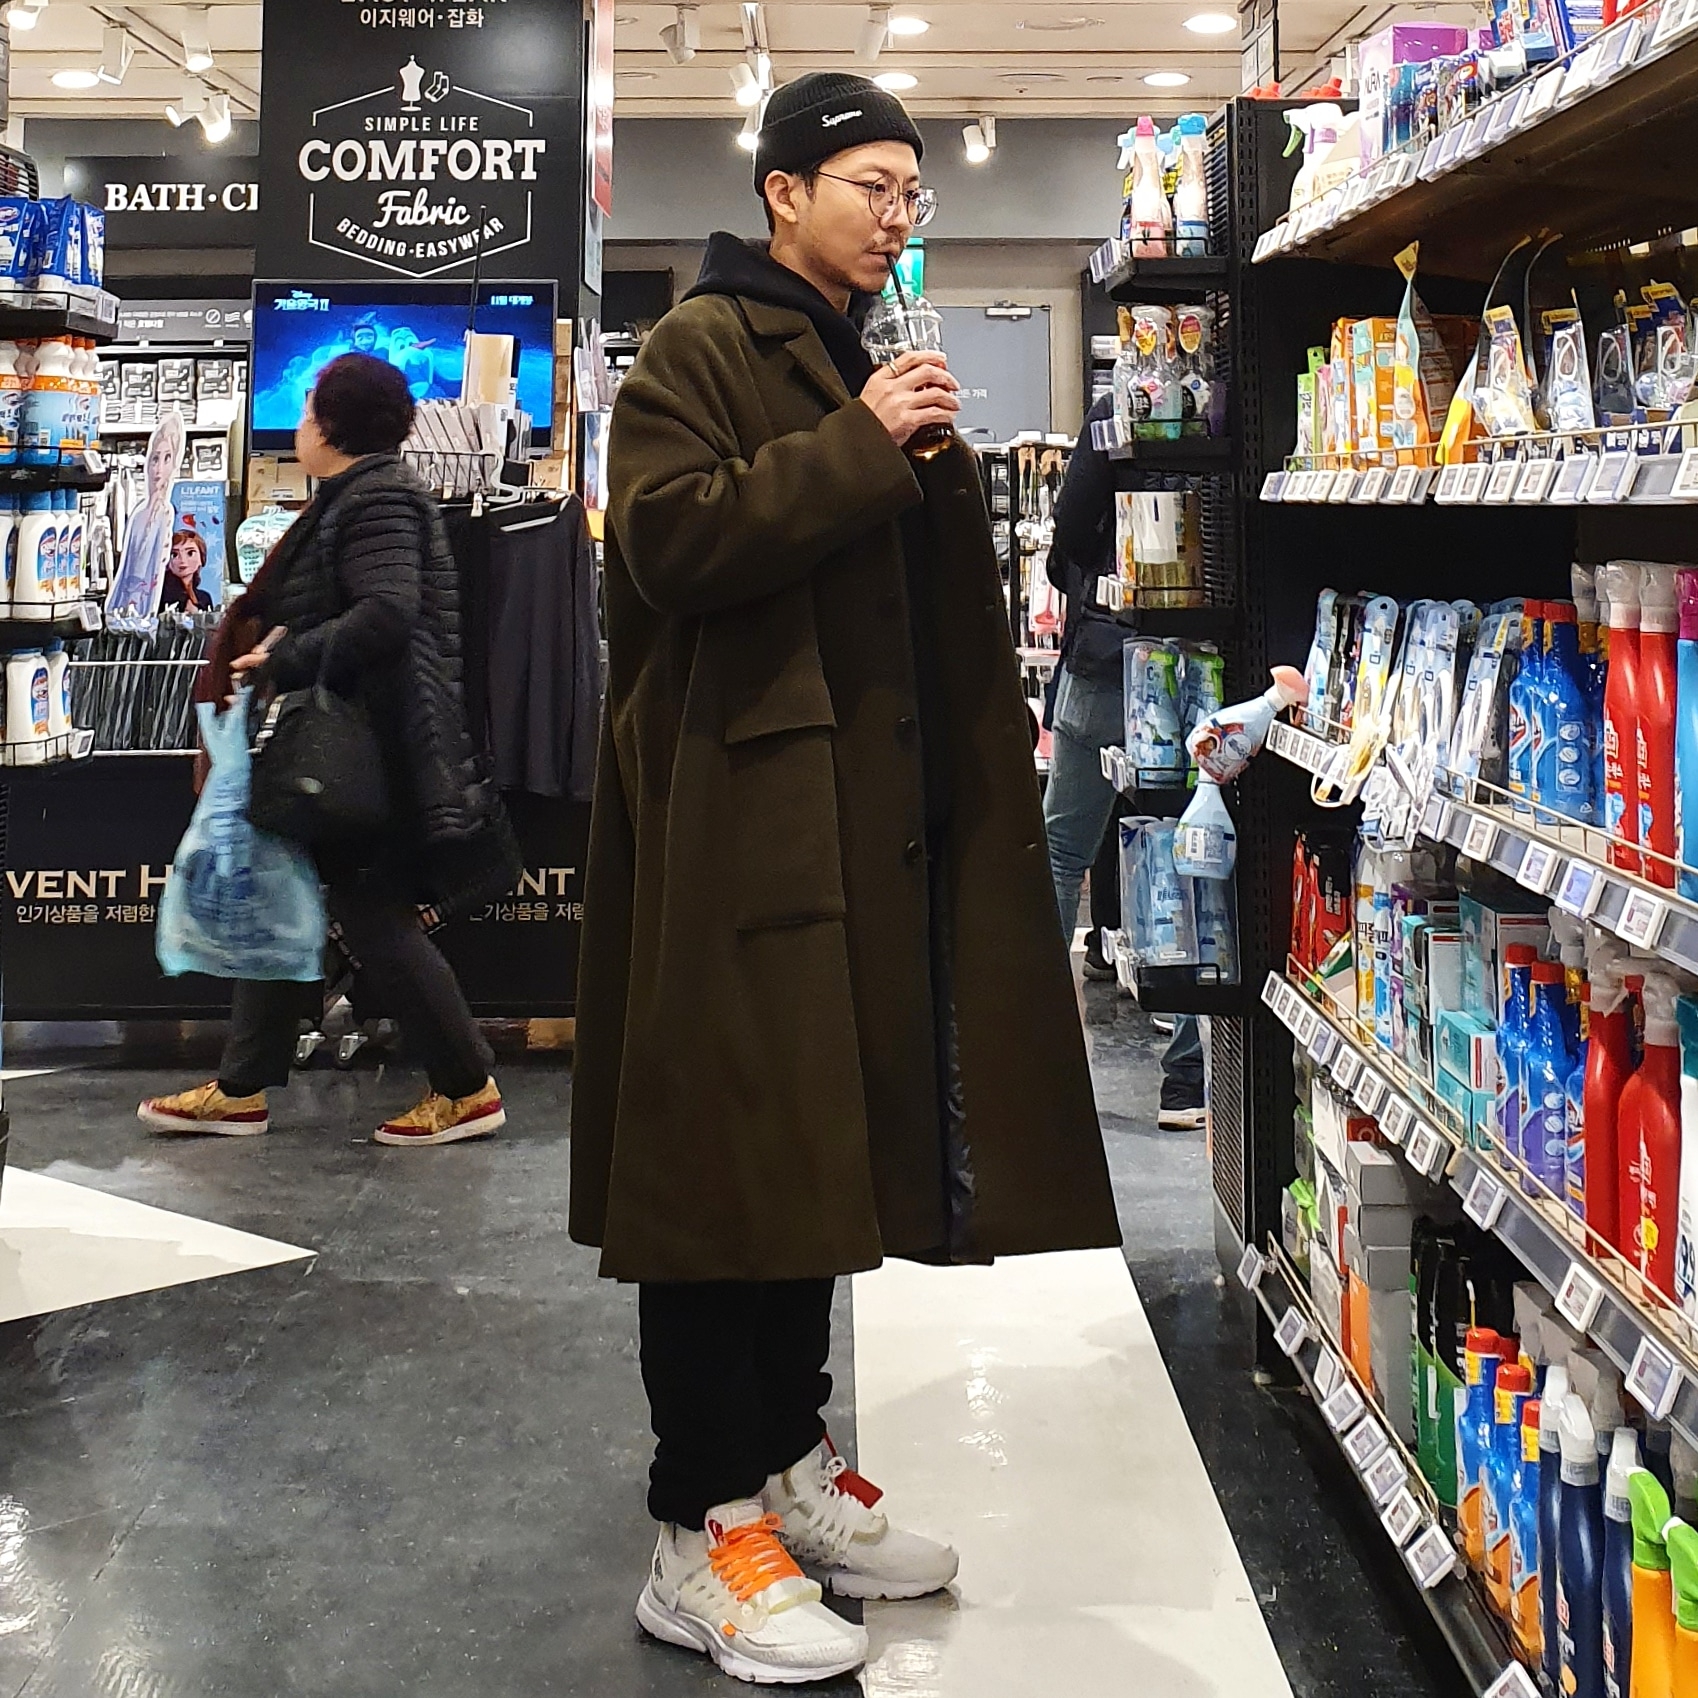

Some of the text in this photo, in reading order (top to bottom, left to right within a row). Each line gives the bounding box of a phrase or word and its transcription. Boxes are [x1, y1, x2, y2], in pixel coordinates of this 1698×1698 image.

[364, 116, 479, 132] SIMPLE LIFE
[298, 139, 546, 182] COMFORT
[373, 187, 471, 228] Fabric
[5, 869, 127, 899] VENT
[506, 867, 576, 896] NT
[16, 903, 156, 923] 인기상품을 저렴한
